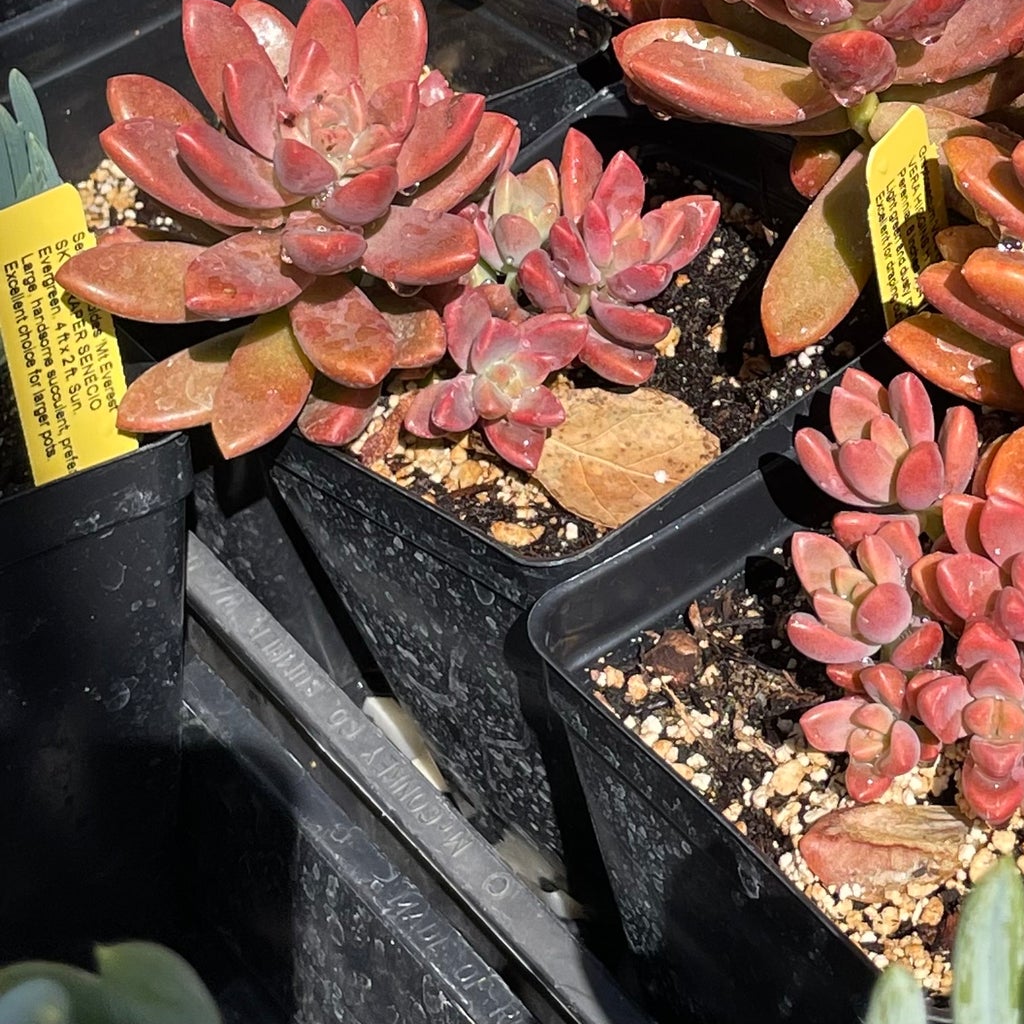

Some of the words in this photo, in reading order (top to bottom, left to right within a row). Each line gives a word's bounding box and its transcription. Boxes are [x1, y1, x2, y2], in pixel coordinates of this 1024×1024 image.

[908, 159, 919, 195] VERA
[886, 179, 896, 210] Light
[875, 190, 890, 242] Excellent
[883, 242, 892, 259] for
[4, 262, 28, 327] Excellent
[55, 322, 67, 331] 4
[57, 332, 70, 345] ft
[18, 325, 36, 369] choice
[59, 346, 68, 356] x
[63, 356, 75, 367] 2
[28, 365, 42, 386] for
[30, 298, 54, 367] handsome
[47, 369, 70, 436] succulent,
[78, 344, 102, 411] SENECIO
[32, 387, 50, 427] larger
[68, 383, 82, 415] Sun.
